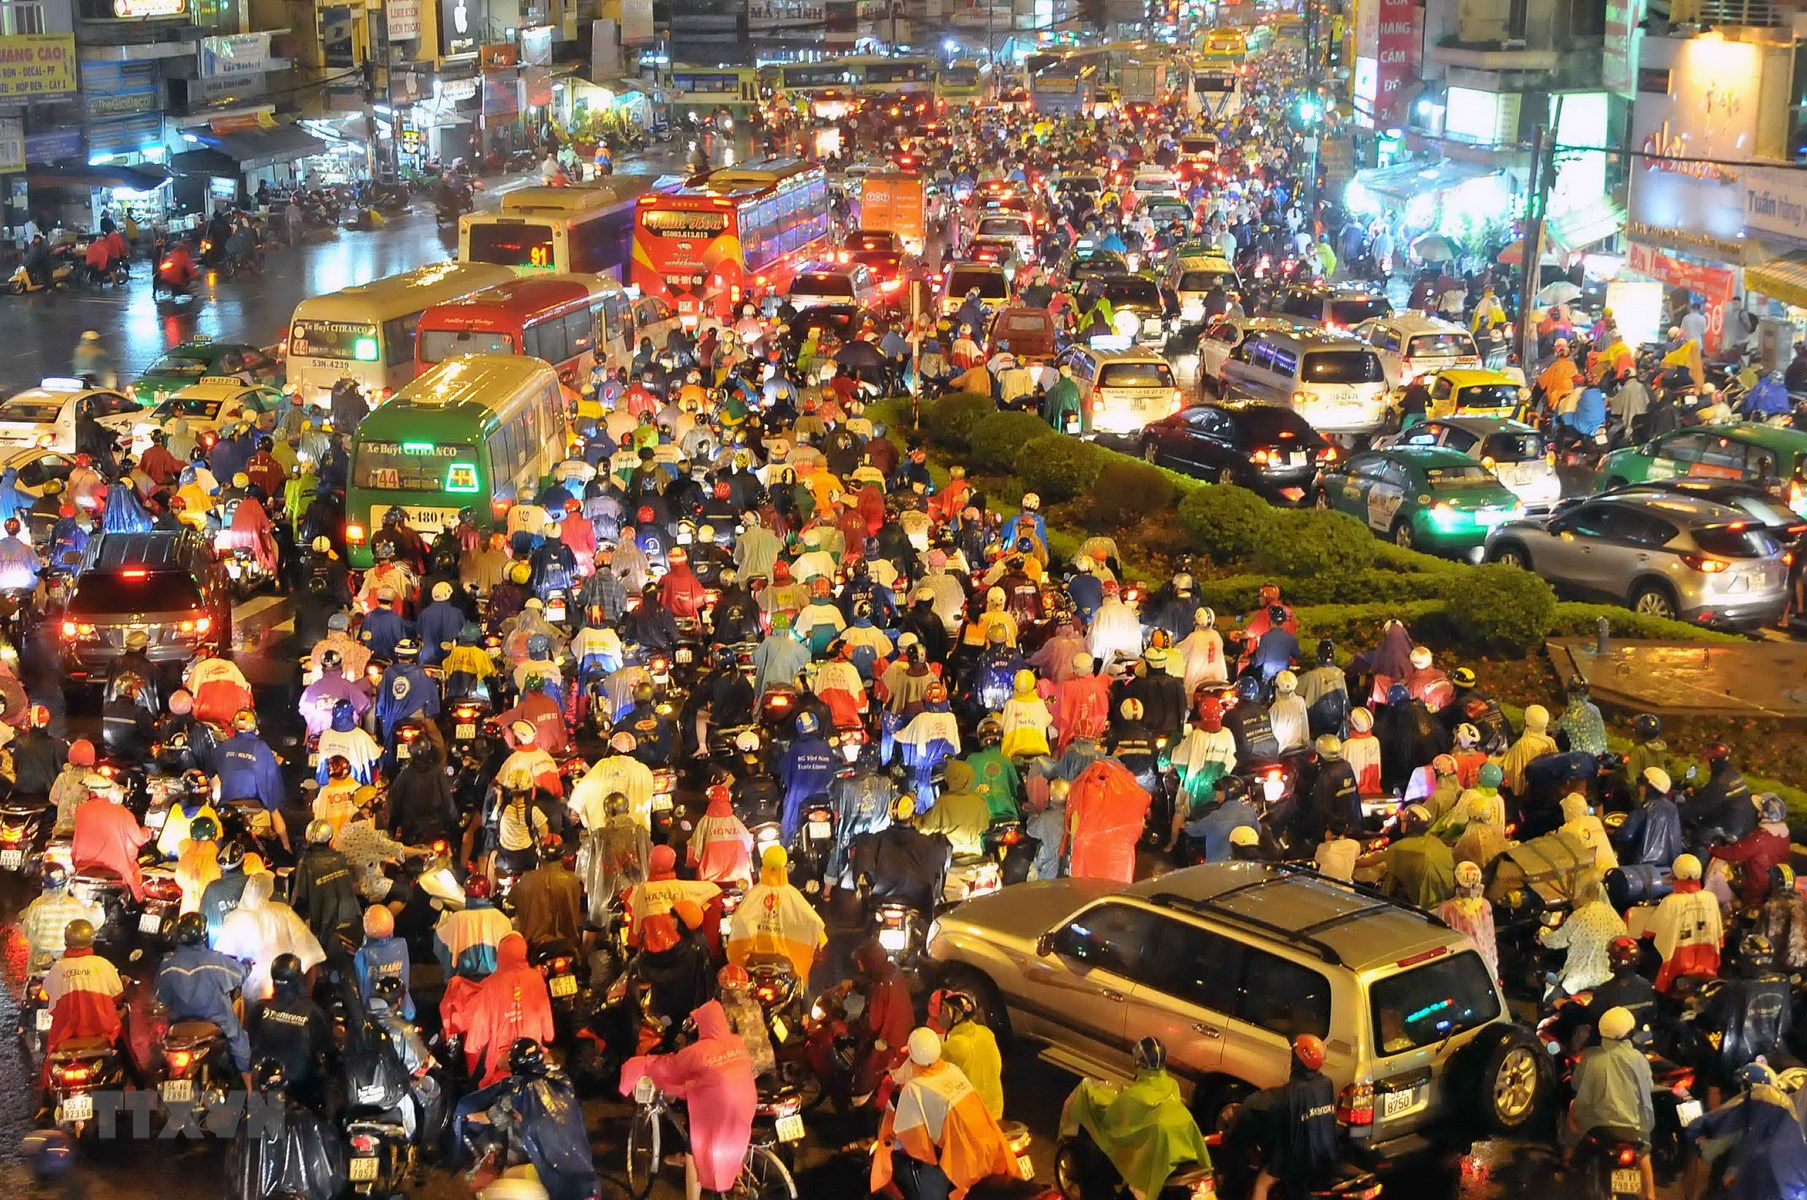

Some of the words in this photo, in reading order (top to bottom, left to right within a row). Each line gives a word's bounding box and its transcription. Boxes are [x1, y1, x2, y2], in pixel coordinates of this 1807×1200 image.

[1748, 189, 1776, 217] Tuấn
[531, 246, 547, 266] 91
[331, 325, 368, 335] CITRANCO
[294, 340, 309, 355] 44
[367, 443, 380, 453] Xe
[379, 469, 397, 488] 44
[269, 1010, 309, 1023] Transcend
[1387, 1096, 1409, 1113] 8750
